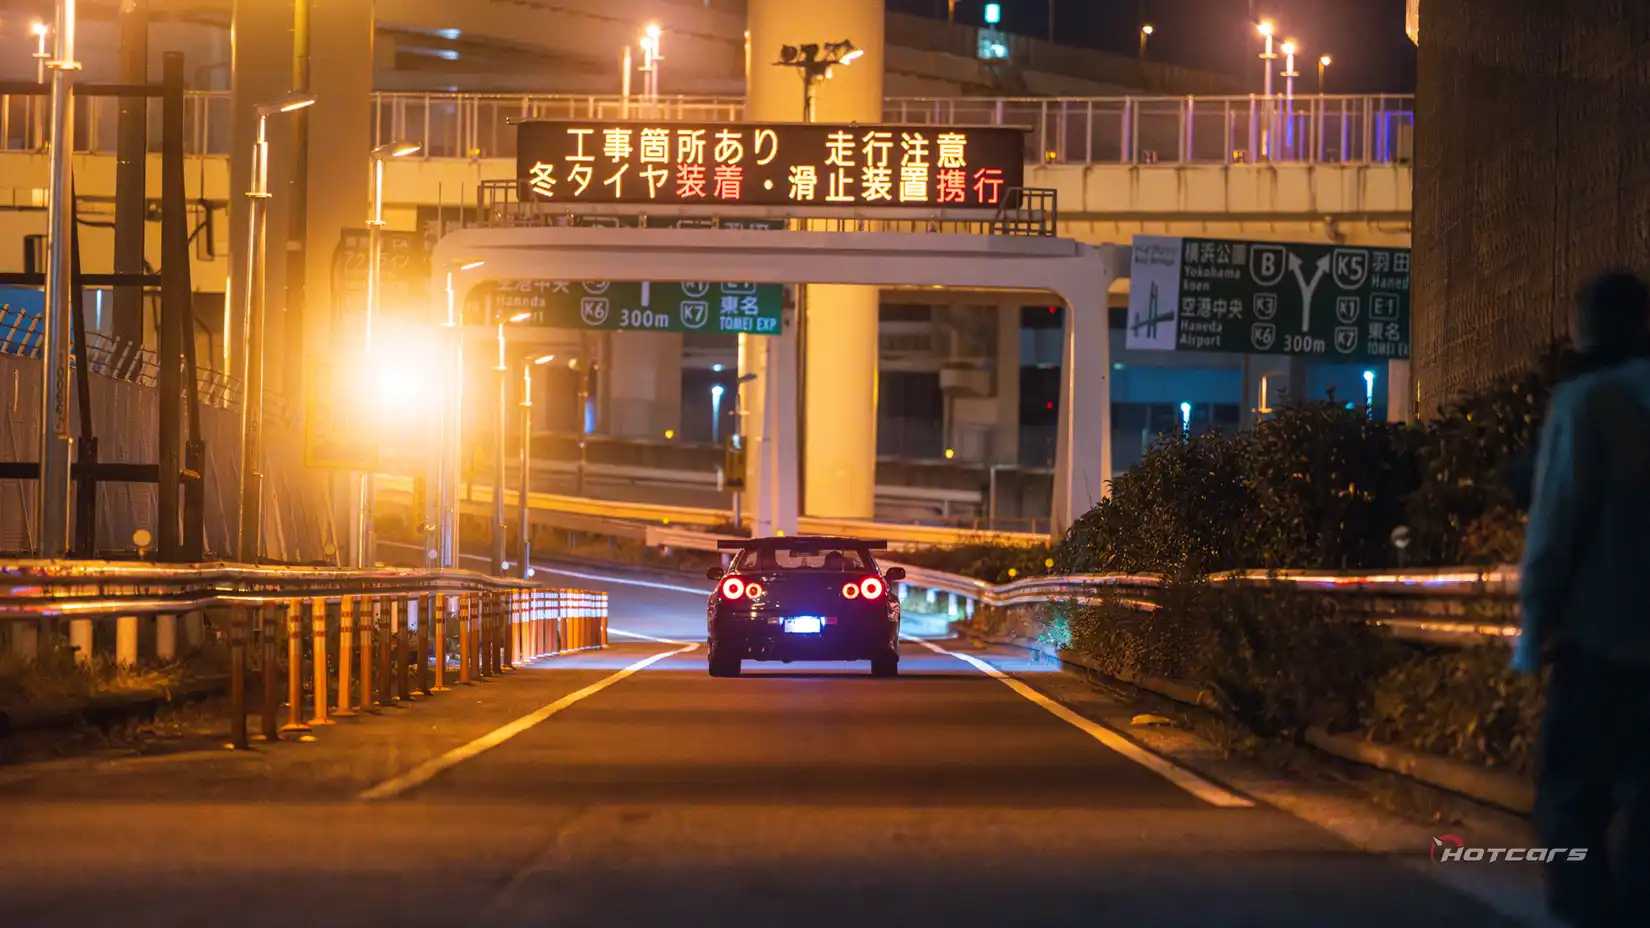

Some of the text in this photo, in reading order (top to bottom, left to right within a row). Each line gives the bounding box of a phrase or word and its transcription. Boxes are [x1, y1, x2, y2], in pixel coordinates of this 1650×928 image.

[565, 128, 967, 168] 工事箇所あり 走行注意
[1338, 257, 1363, 284] K5
[584, 302, 605, 319] K6
[684, 305, 704, 323] K7
[1374, 299, 1393, 315] E1
[620, 308, 669, 328] 300m
[1283, 335, 1326, 353] 300m
